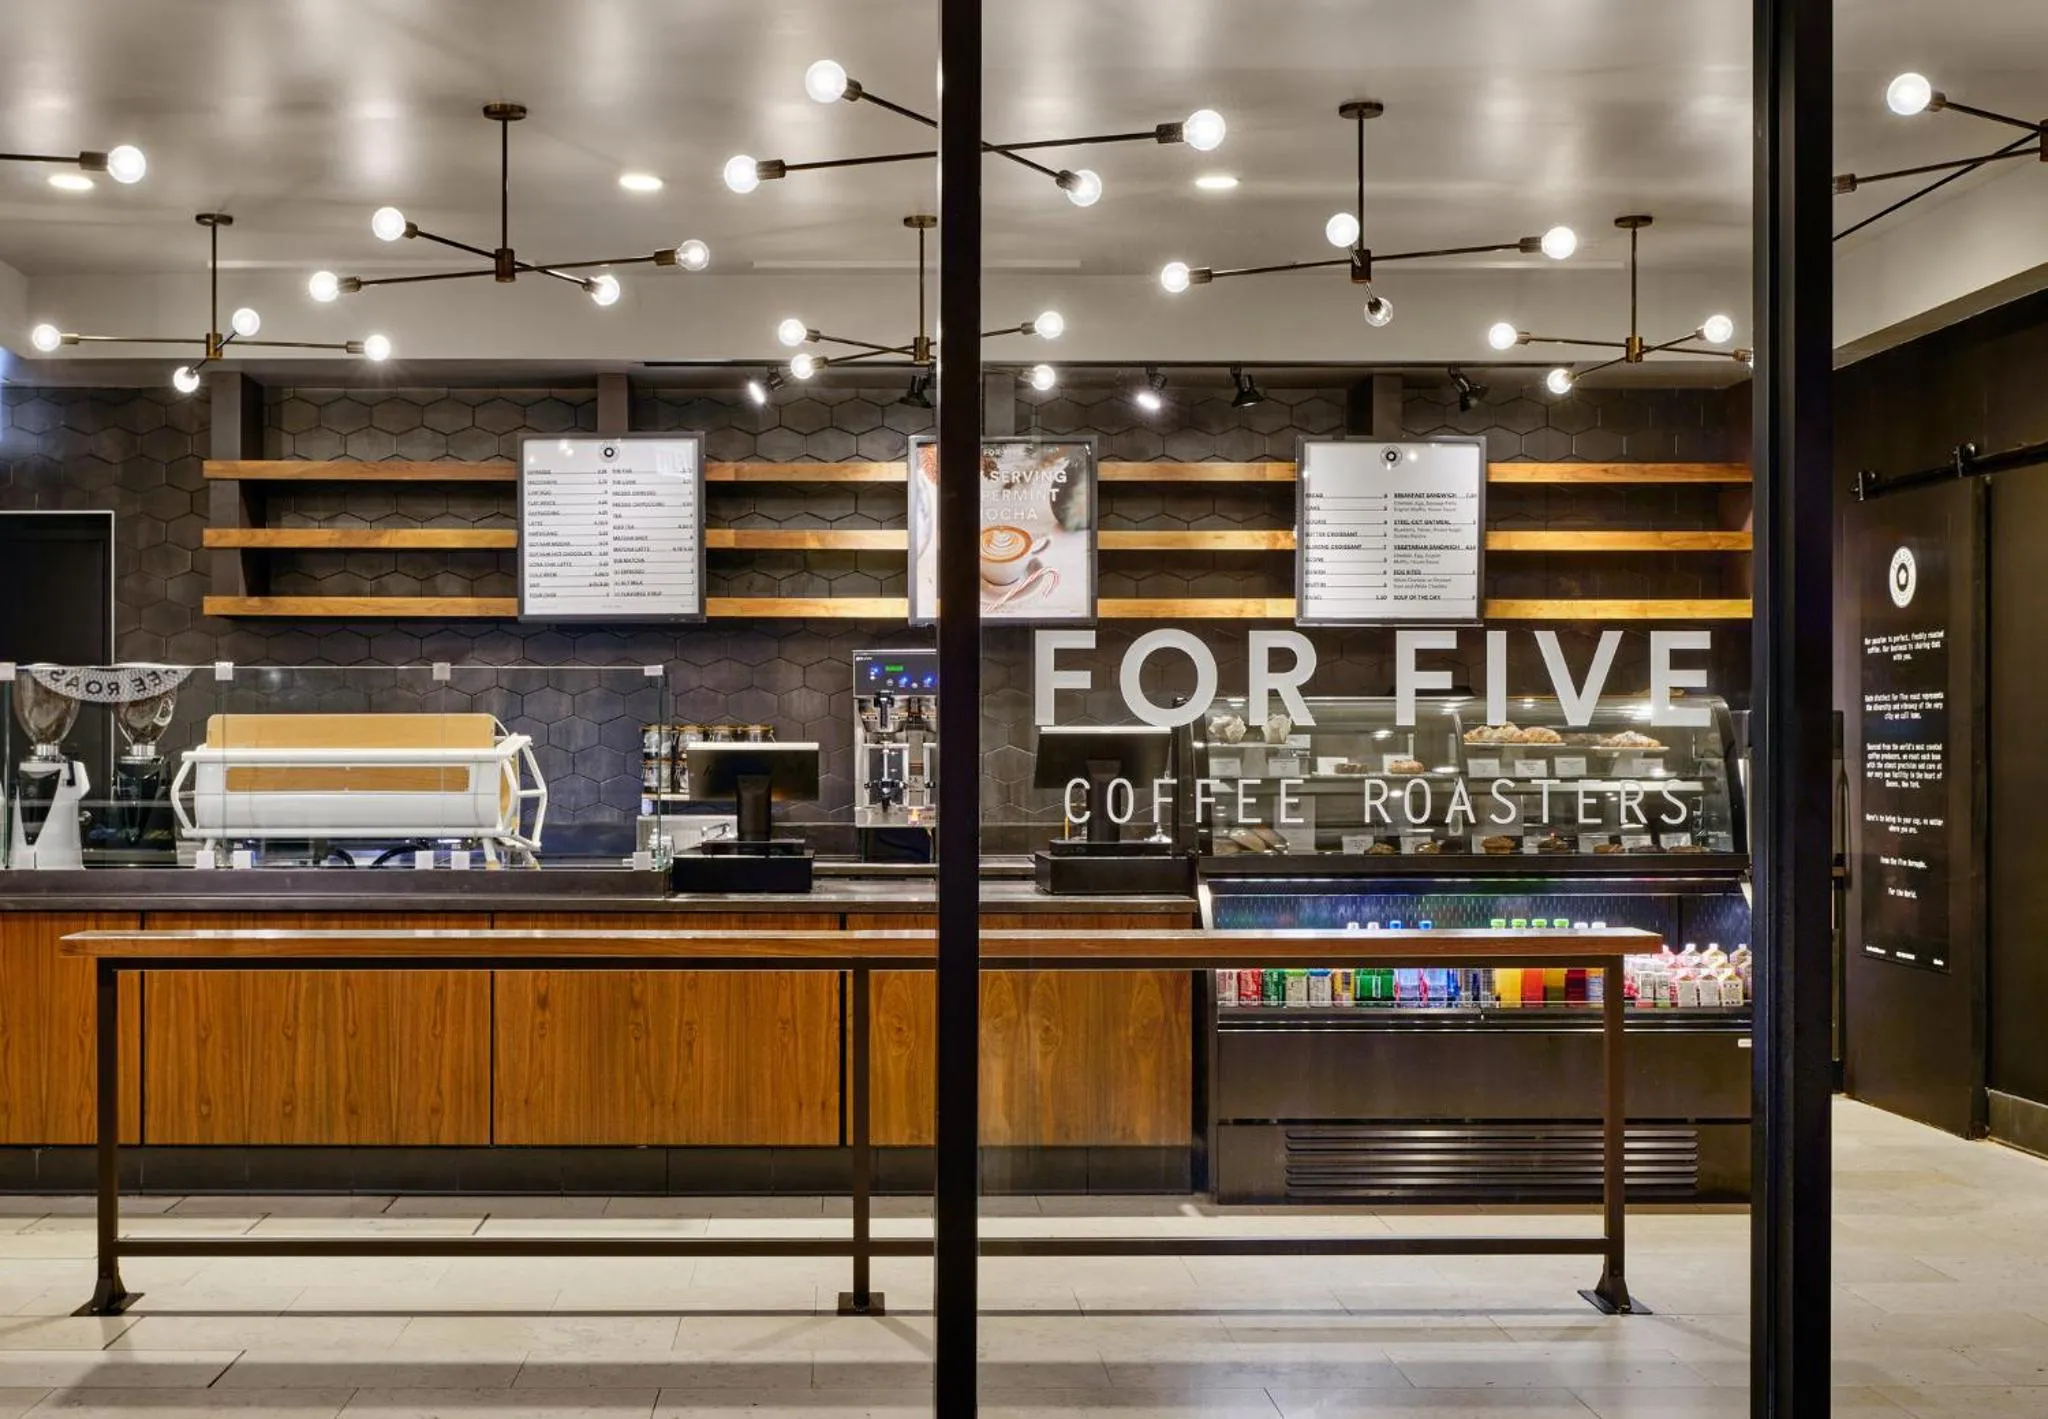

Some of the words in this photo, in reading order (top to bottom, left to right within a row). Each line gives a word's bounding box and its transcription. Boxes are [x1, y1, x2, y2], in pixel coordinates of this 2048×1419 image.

[990, 470, 1067, 483] SERVING
[985, 508, 1038, 521] OCHA
[1034, 628, 1317, 728] FOR
[1396, 630, 1712, 727] FIVE
[1064, 778, 1305, 825] COFFEE
[1364, 777, 1689, 825] ROASTERS
